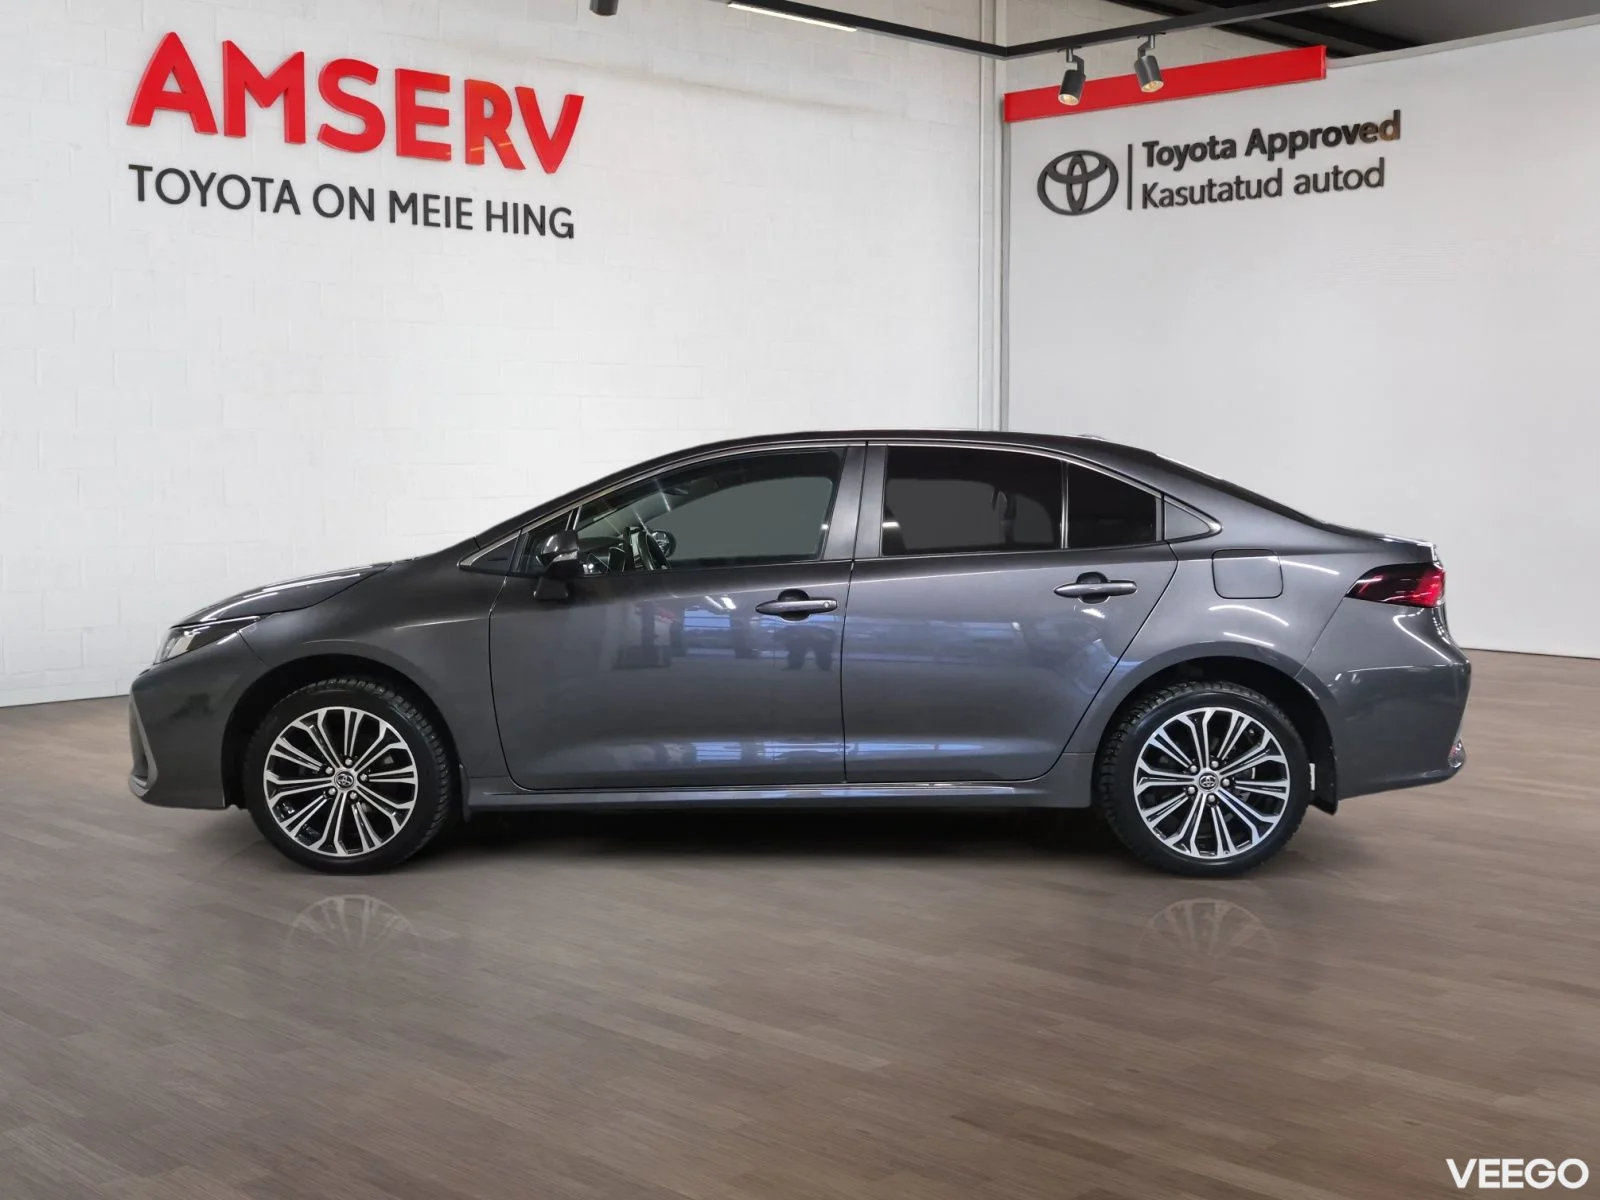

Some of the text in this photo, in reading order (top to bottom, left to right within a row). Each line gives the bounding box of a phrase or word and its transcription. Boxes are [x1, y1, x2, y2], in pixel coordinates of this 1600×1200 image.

[126, 31, 584, 174] AMSERV
[1142, 109, 1401, 172] Toyota Approved
[128, 164, 575, 239] TOYOTA ON MEIE HING
[1141, 157, 1385, 209] Kasutatud autod
